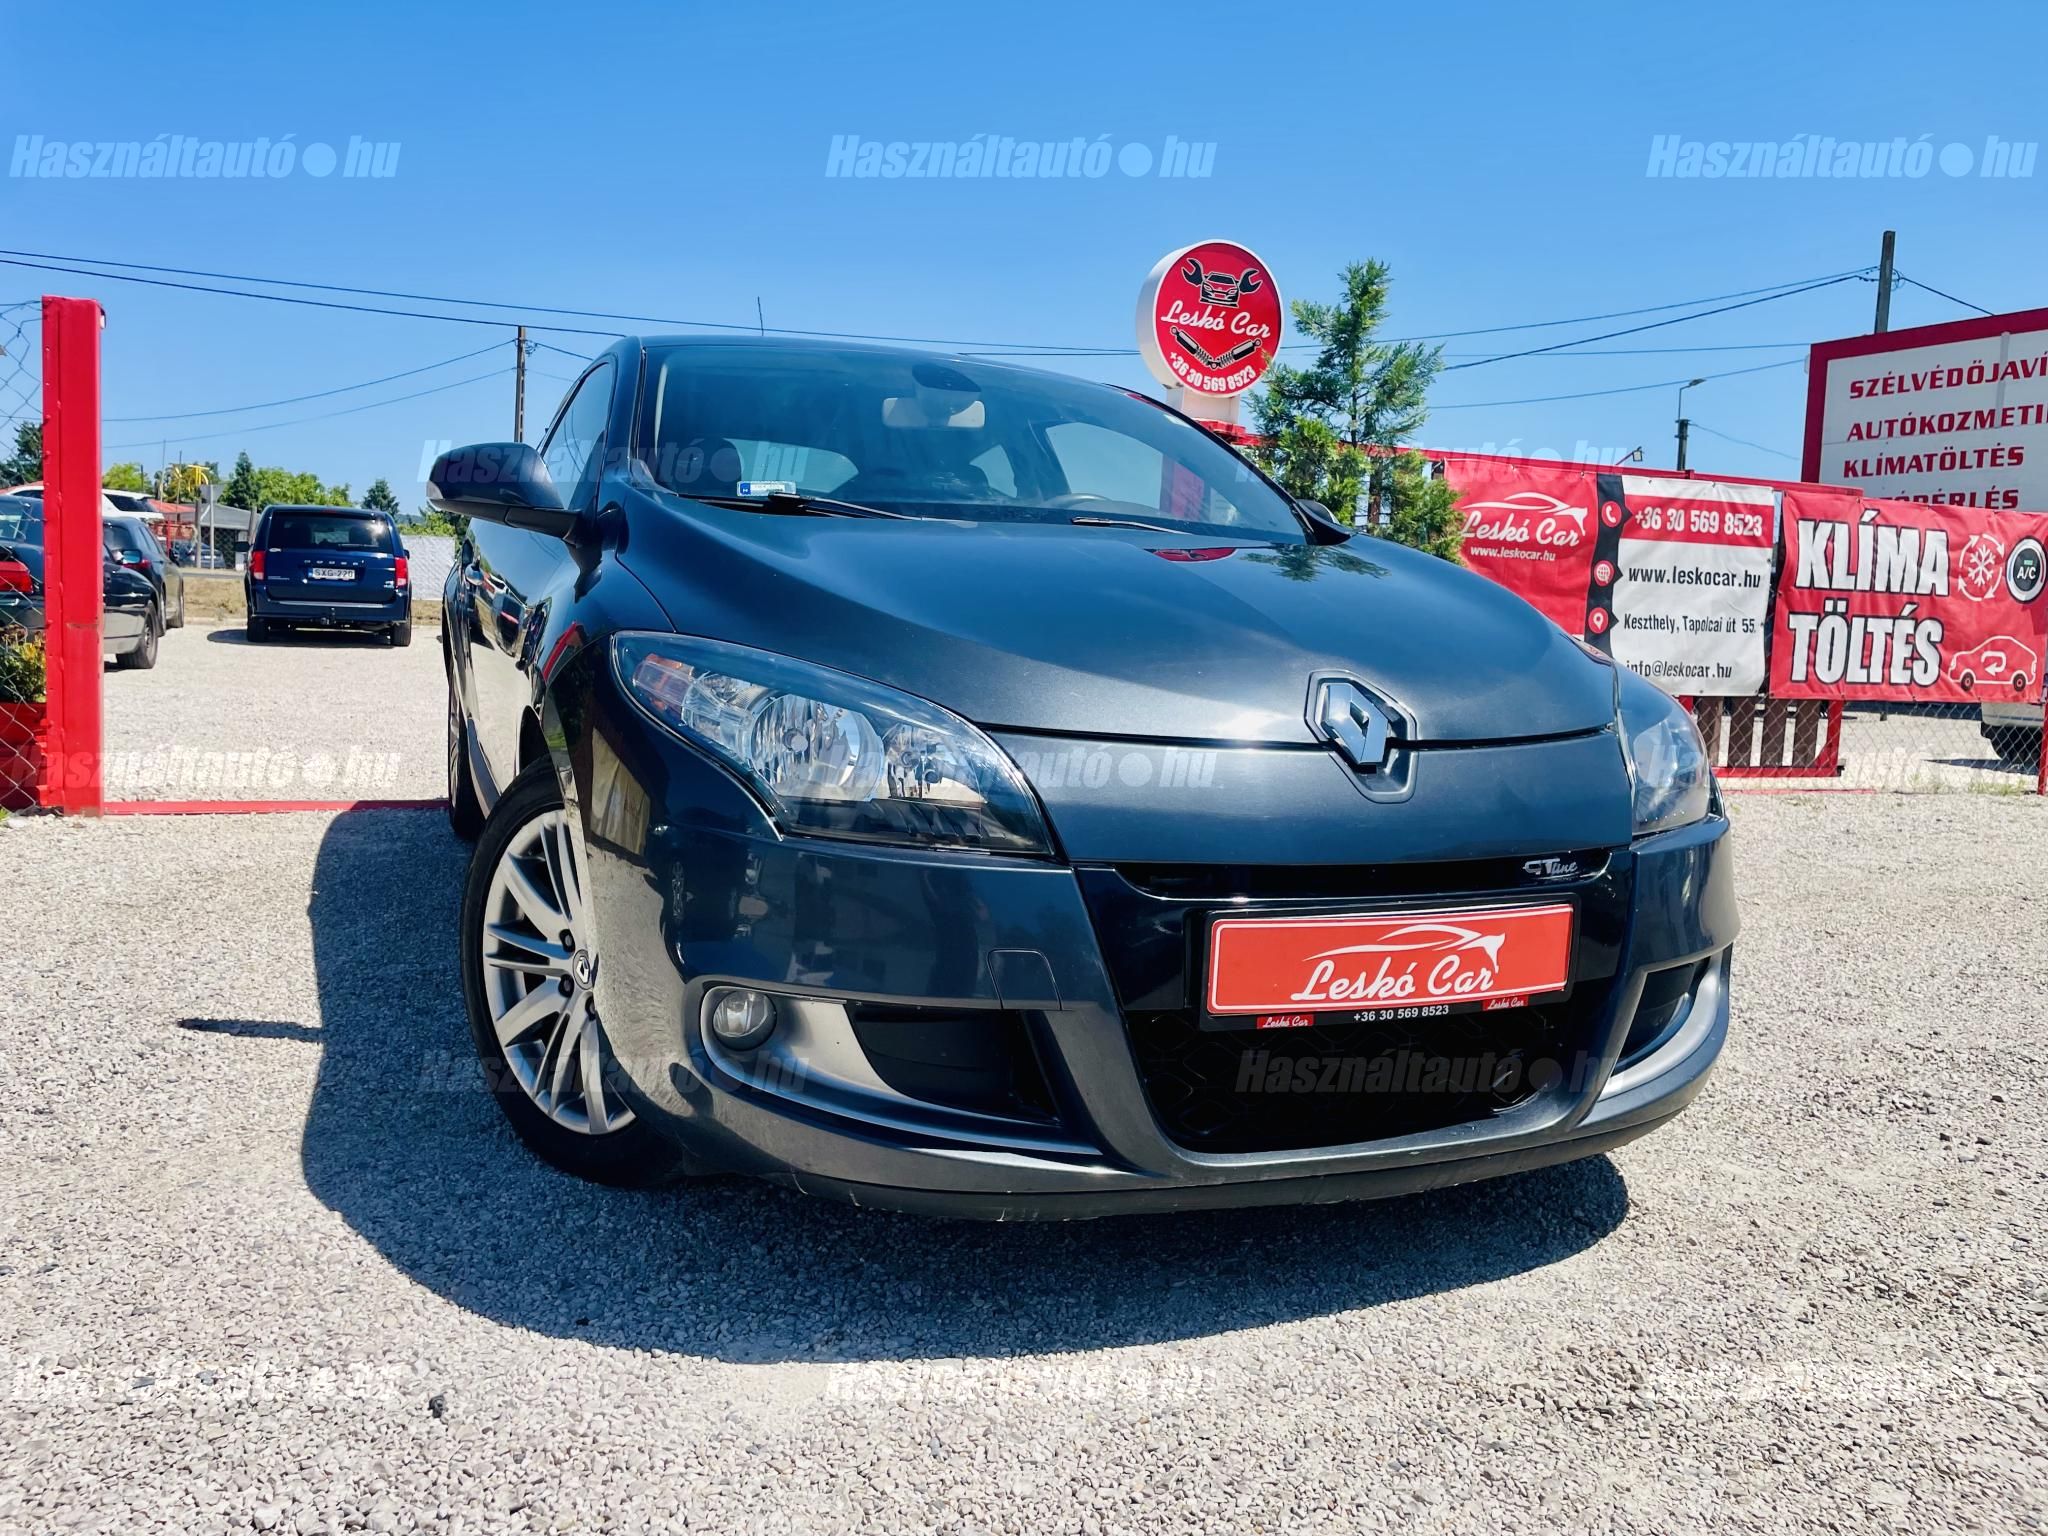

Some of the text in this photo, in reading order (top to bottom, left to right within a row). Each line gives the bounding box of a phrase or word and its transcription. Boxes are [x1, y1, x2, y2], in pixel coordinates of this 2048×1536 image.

[1161, 300, 1270, 338] Leskó Car
[1170, 352, 1256, 391] +36 30 569 8523
[1847, 404, 2048, 442] AUTÓKOZMETI
[1843, 442, 2025, 478] KLÍMATÖLTÉS
[1460, 510, 1580, 547] Leskó Car
[1635, 506, 1762, 536] +36 30 569 8523
[1470, 546, 1556, 561] www.leskocar.hu
[1797, 510, 1949, 596] KLÍMA
[1628, 565, 1760, 588] www.leskocar.hu
[2017, 566, 2036, 580] A/C
[1624, 613, 1680, 634] Keszthely,
[1682, 615, 1723, 635] Tapolcai
[1726, 617, 1737, 633] út
[1788, 599, 1944, 687] TÖLTÉS
[1626, 660, 1732, 679] info@leskocar.hu
[1290, 954, 1494, 1001] Leskó Car
[1291, 1016, 1308, 1027] Car
[1353, 1004, 1449, 1022] +36 30 569 8523
